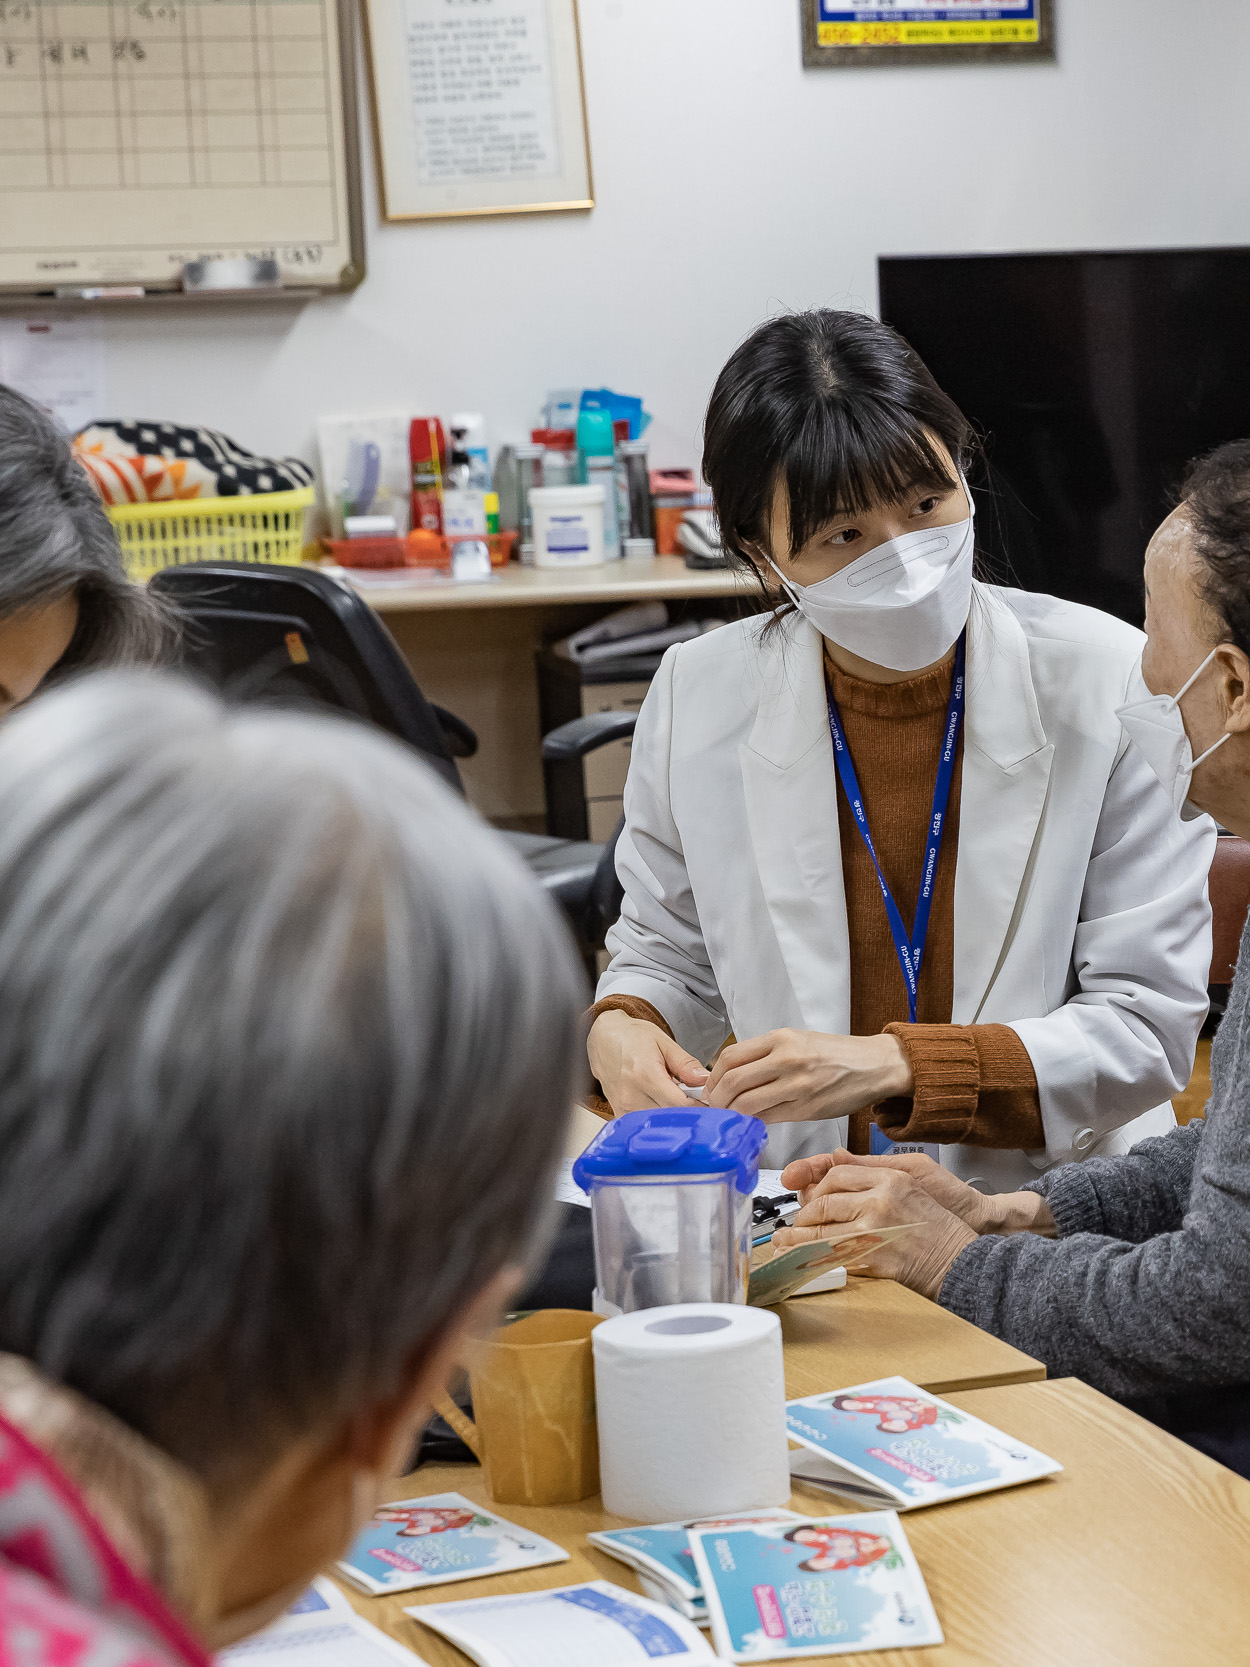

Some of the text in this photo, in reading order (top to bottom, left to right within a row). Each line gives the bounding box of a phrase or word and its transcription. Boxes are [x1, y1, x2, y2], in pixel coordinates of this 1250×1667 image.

[944, 676, 963, 762] 광진구 GWANGJIN-GU
[853, 800, 865, 822] 광진구
[922, 812, 942, 898] 광진구 GWANGJIN-GU
[900, 945, 916, 994] GWANGJIN-GU
[892, 1146, 925, 1154] 공무원증
